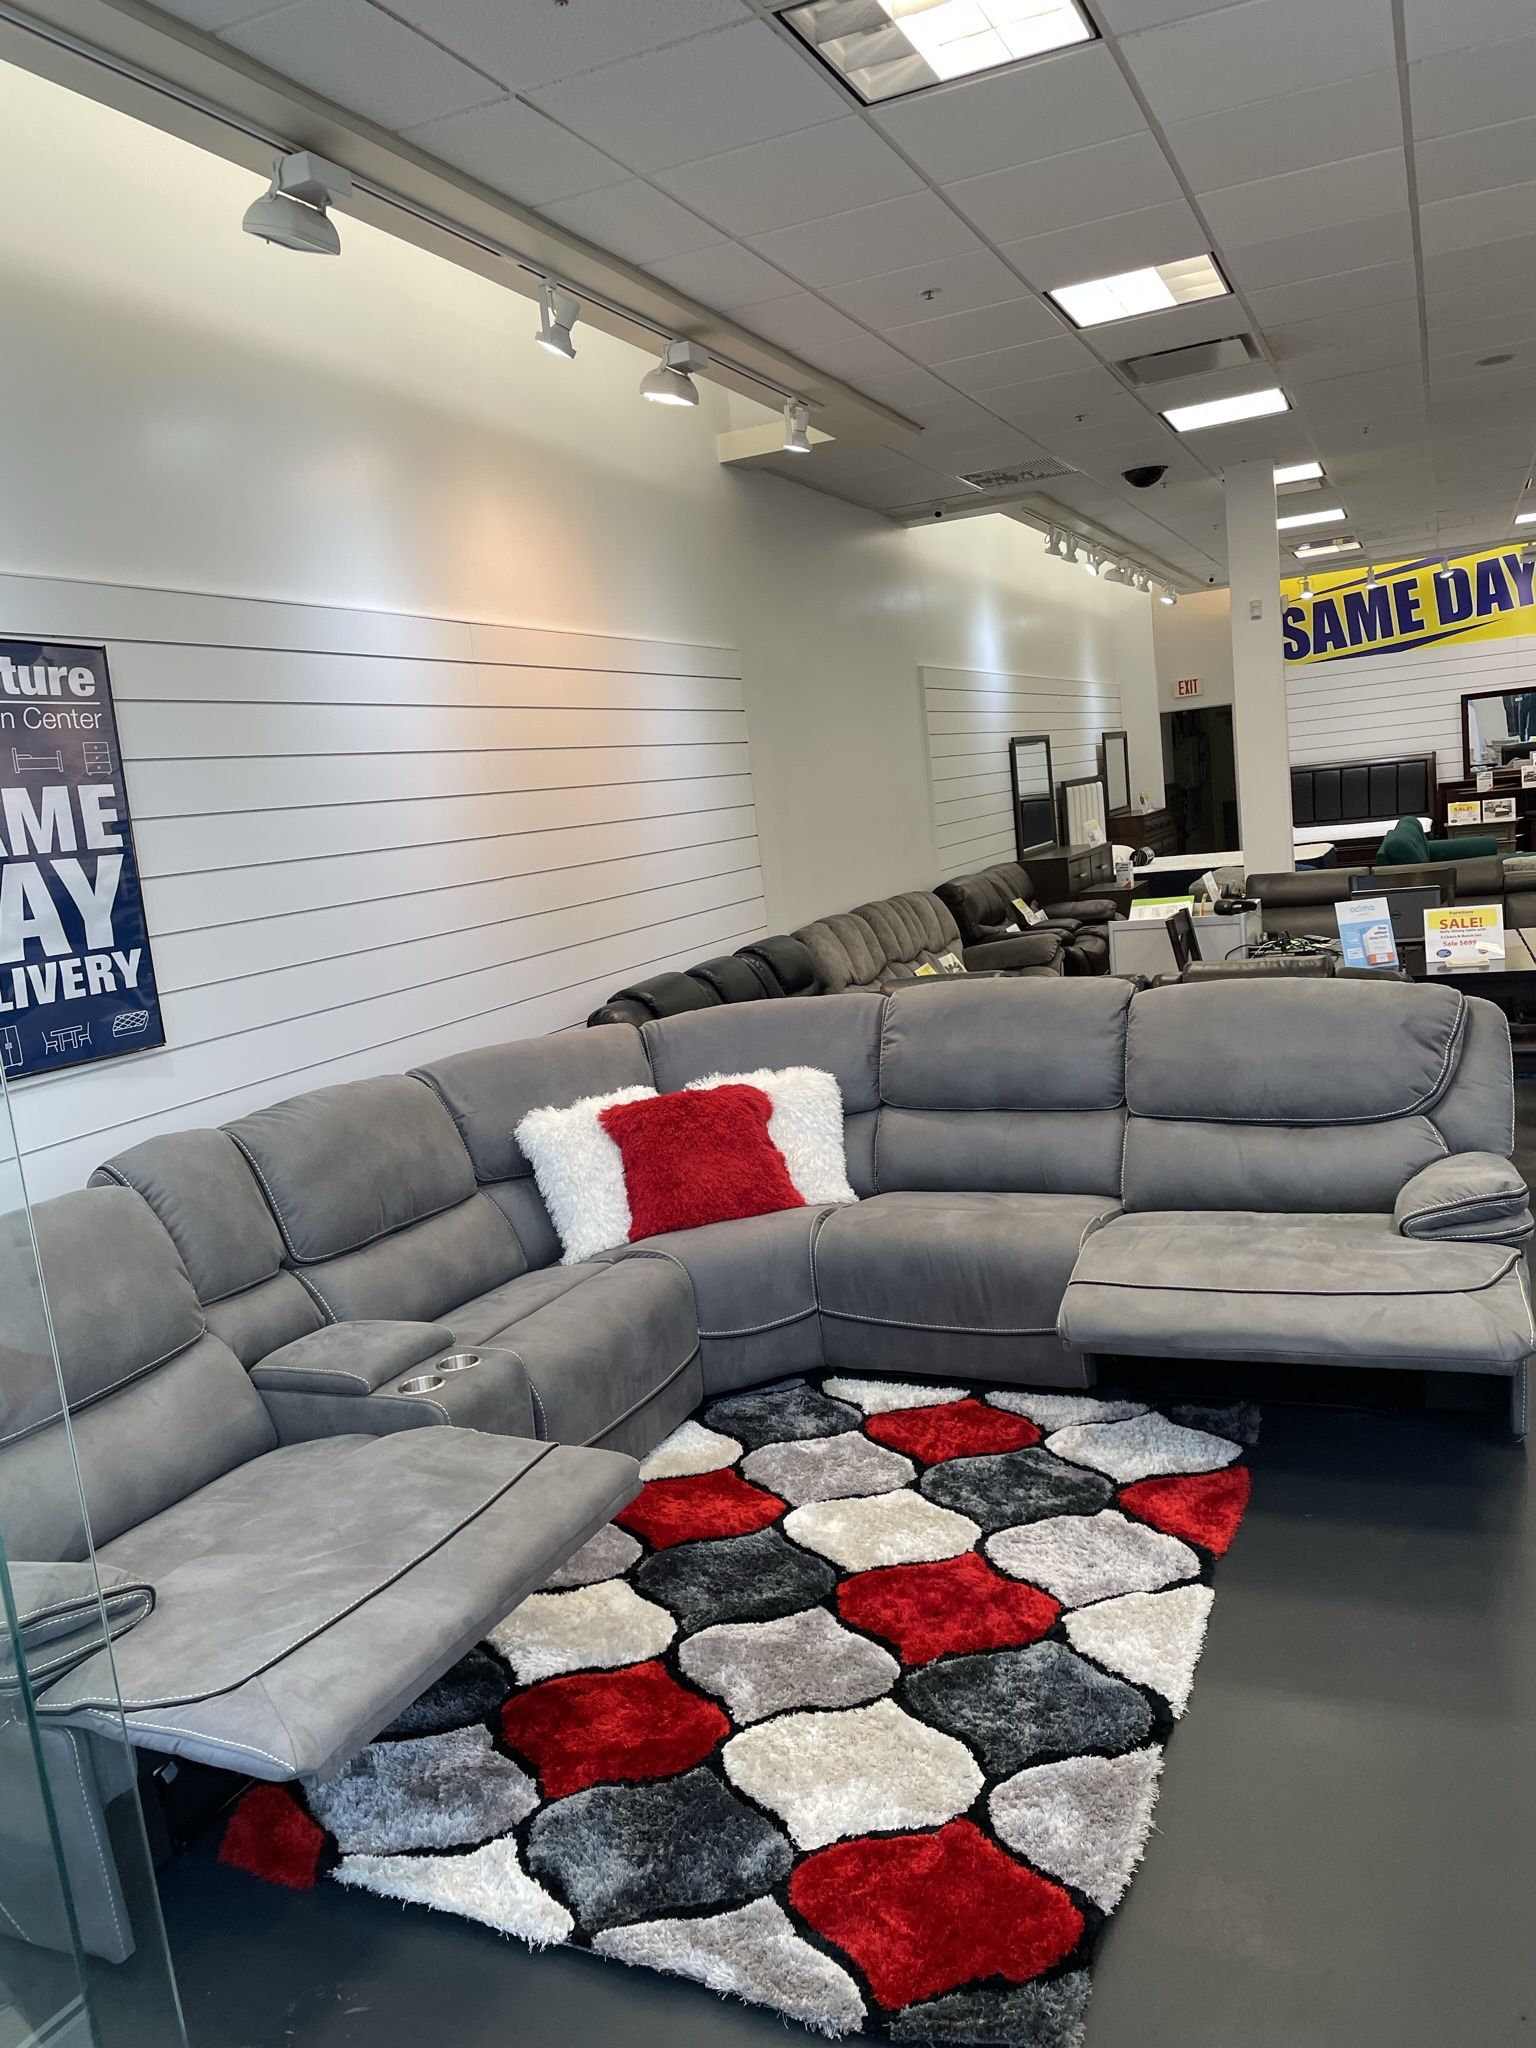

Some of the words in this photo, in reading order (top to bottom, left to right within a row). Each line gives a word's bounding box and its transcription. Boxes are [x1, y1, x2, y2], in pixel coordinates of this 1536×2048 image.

[1283, 578, 1425, 660] SAME
[1433, 553, 1536, 625] DAY
[1178, 679, 1198, 695] EXIT
[23, 706, 102, 729] Center
[0, 783, 124, 857] ME
[1439, 917, 1483, 930] SALE!
